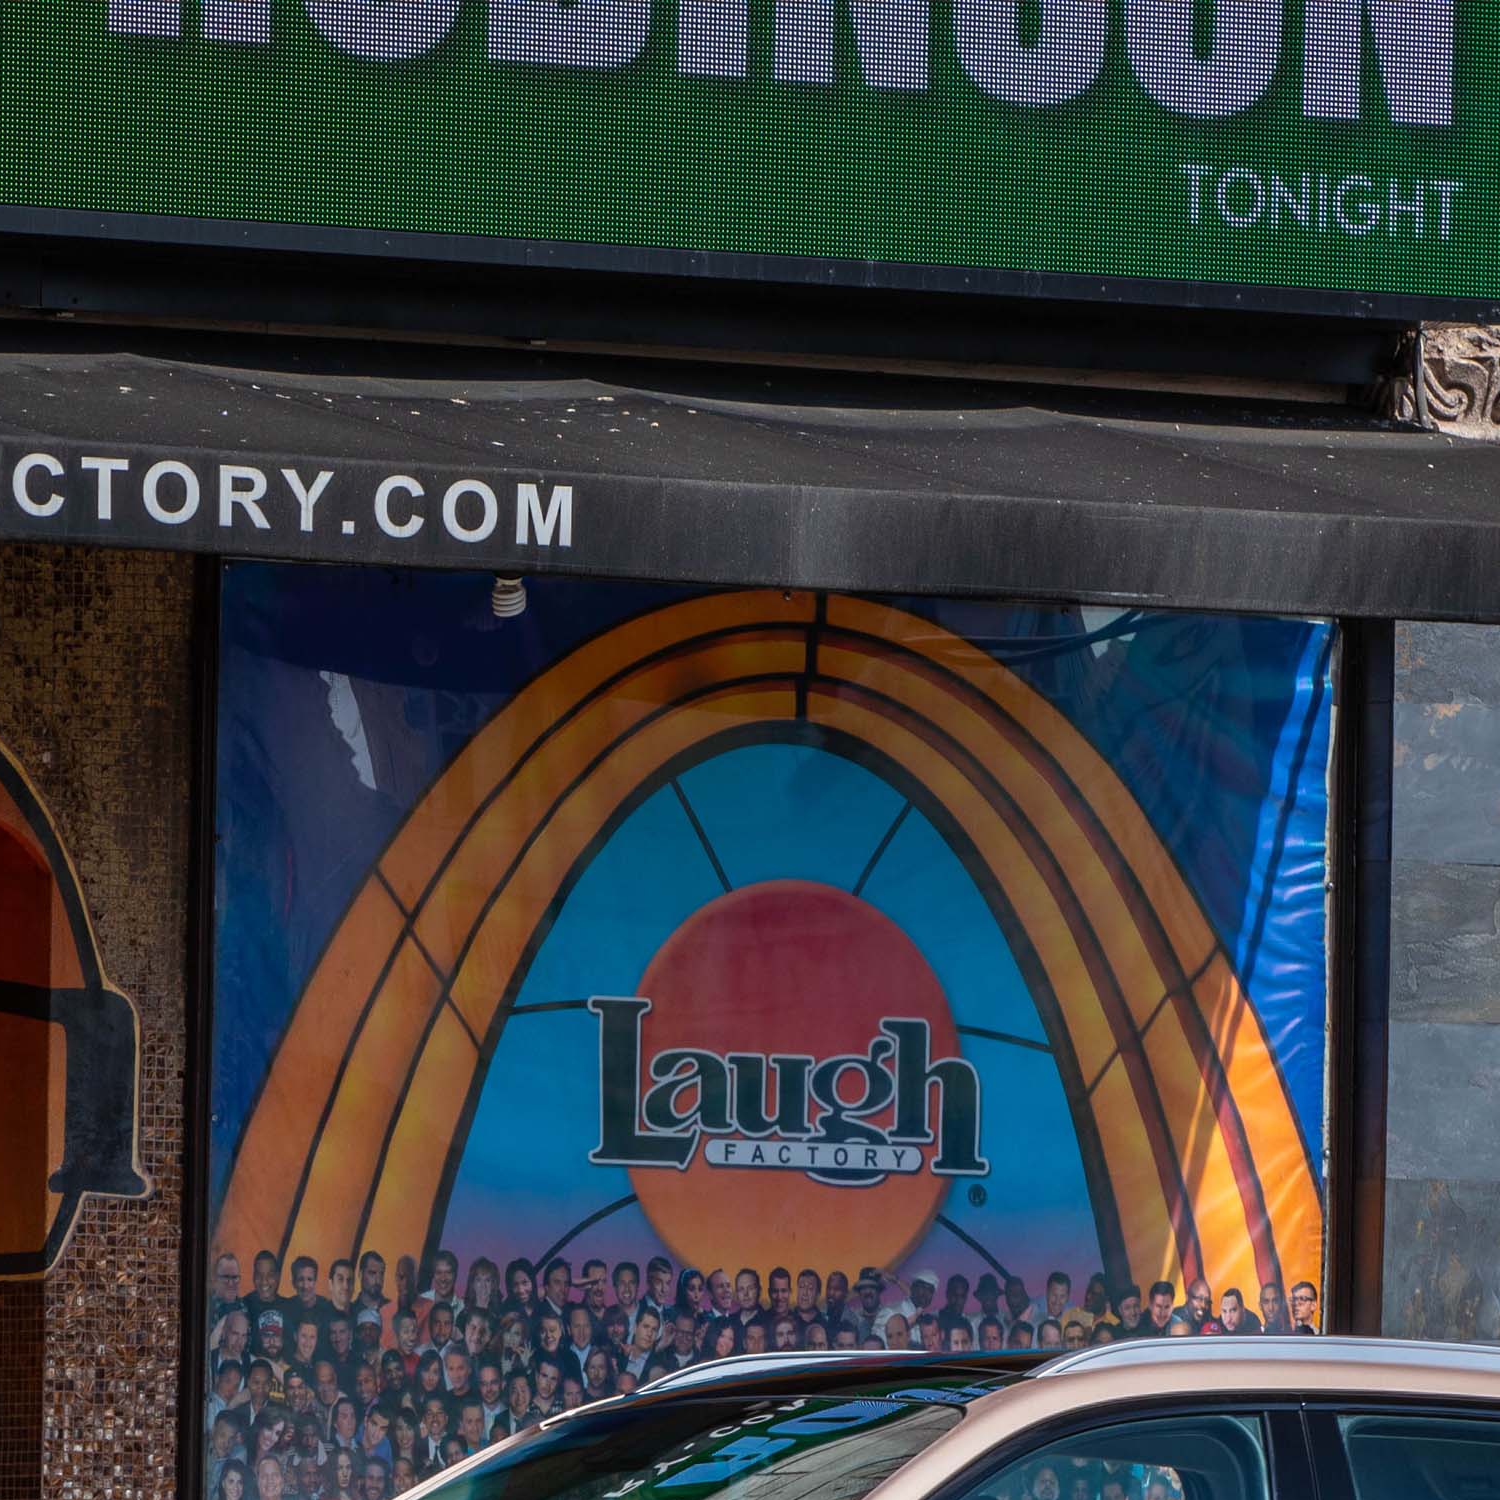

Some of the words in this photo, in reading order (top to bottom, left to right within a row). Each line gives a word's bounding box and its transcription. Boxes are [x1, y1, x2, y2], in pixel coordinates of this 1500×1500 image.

[1178, 163, 1465, 241] TONIGHT
[588, 996, 989, 1186] Laugh
[723, 1143, 907, 1168] FACTORY
